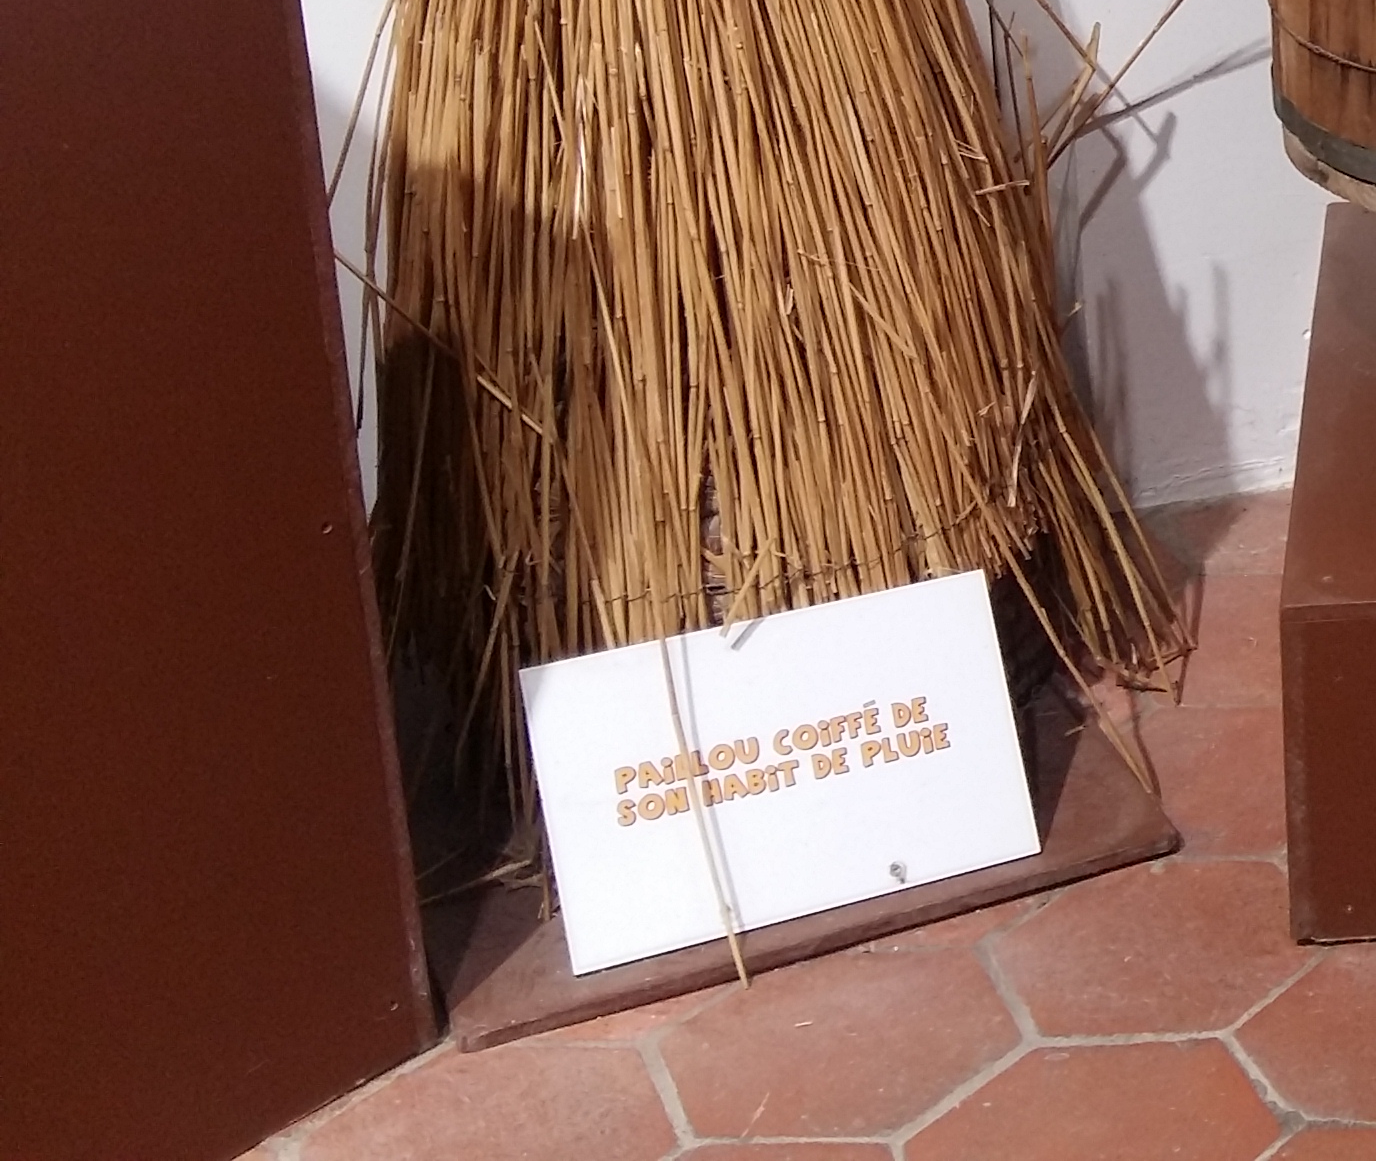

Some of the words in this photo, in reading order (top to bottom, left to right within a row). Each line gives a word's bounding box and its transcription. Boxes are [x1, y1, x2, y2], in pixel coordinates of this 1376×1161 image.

[891, 696, 930, 729] DE
[616, 786, 691, 828] SON
[813, 748, 850, 781] DE
